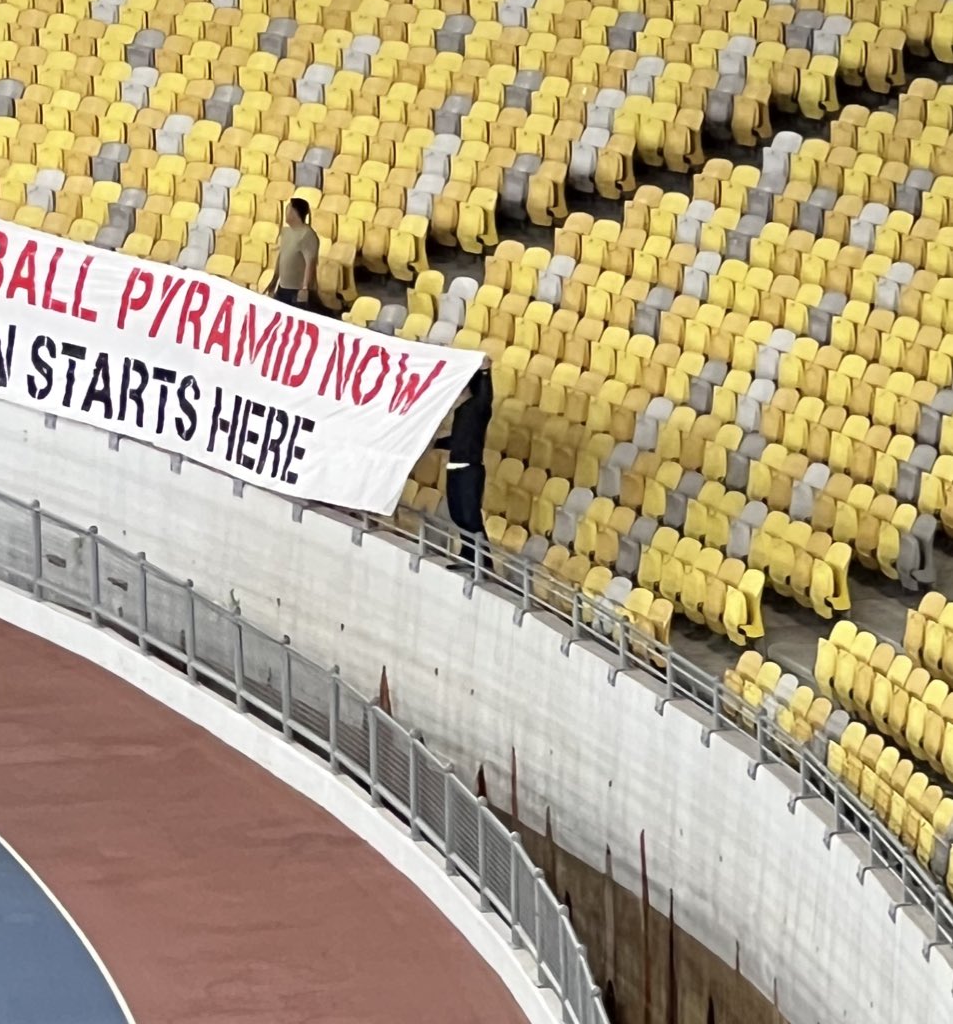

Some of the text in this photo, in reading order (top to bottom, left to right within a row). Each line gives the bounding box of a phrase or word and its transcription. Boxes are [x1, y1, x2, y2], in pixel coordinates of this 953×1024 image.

[26, 334, 201, 443] STARTS
[206, 386, 316, 485] HERE
[117, 267, 320, 388] PYRAMID
[318, 332, 445, 416] NOW
